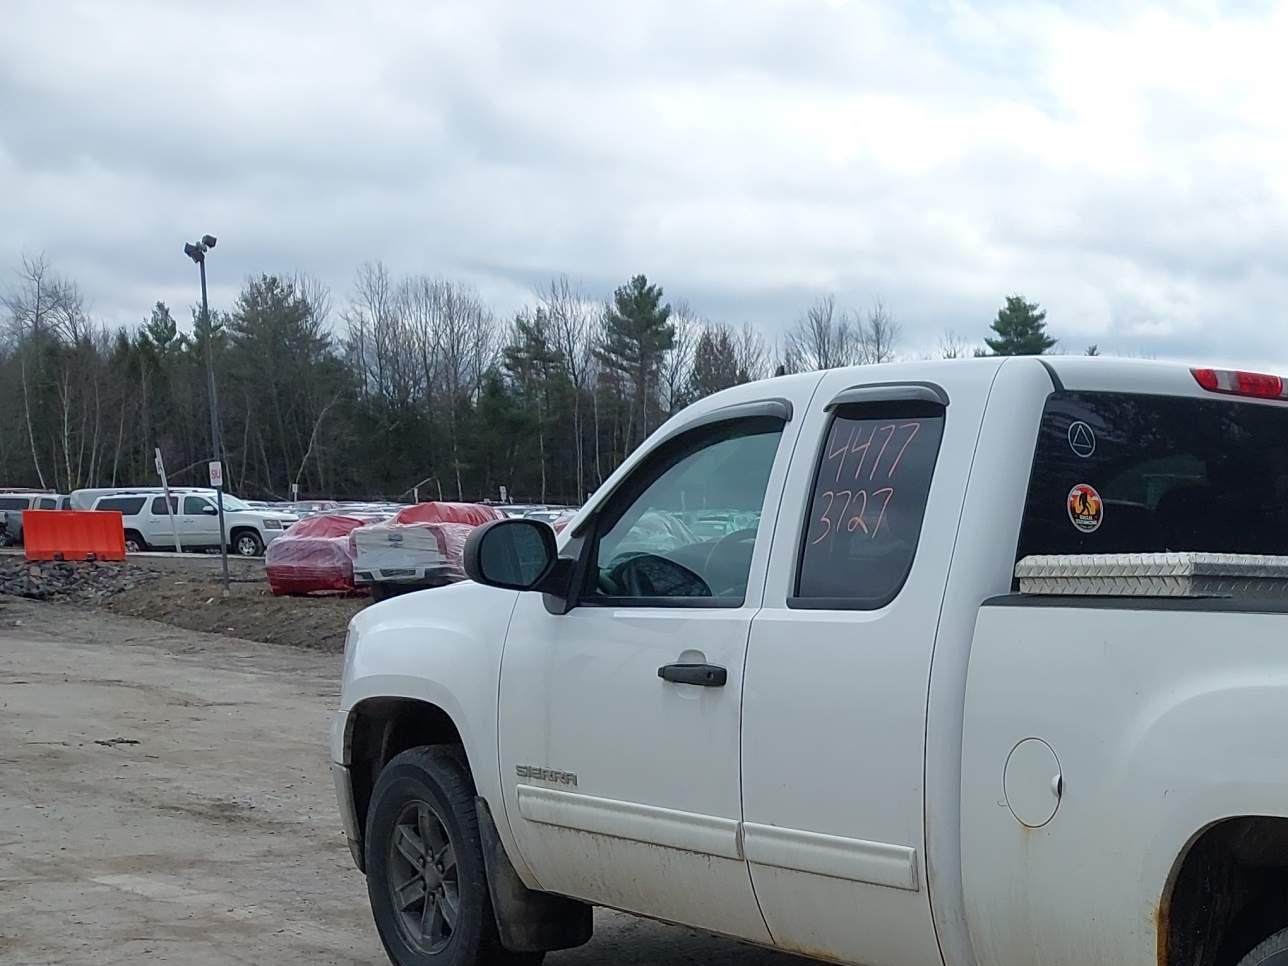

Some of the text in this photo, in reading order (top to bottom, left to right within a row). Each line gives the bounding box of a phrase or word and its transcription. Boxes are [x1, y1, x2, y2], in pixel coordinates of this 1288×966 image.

[828, 422, 921, 483] 4477
[811, 487, 894, 545] 3727
[515, 765, 578, 786] SIERRA
